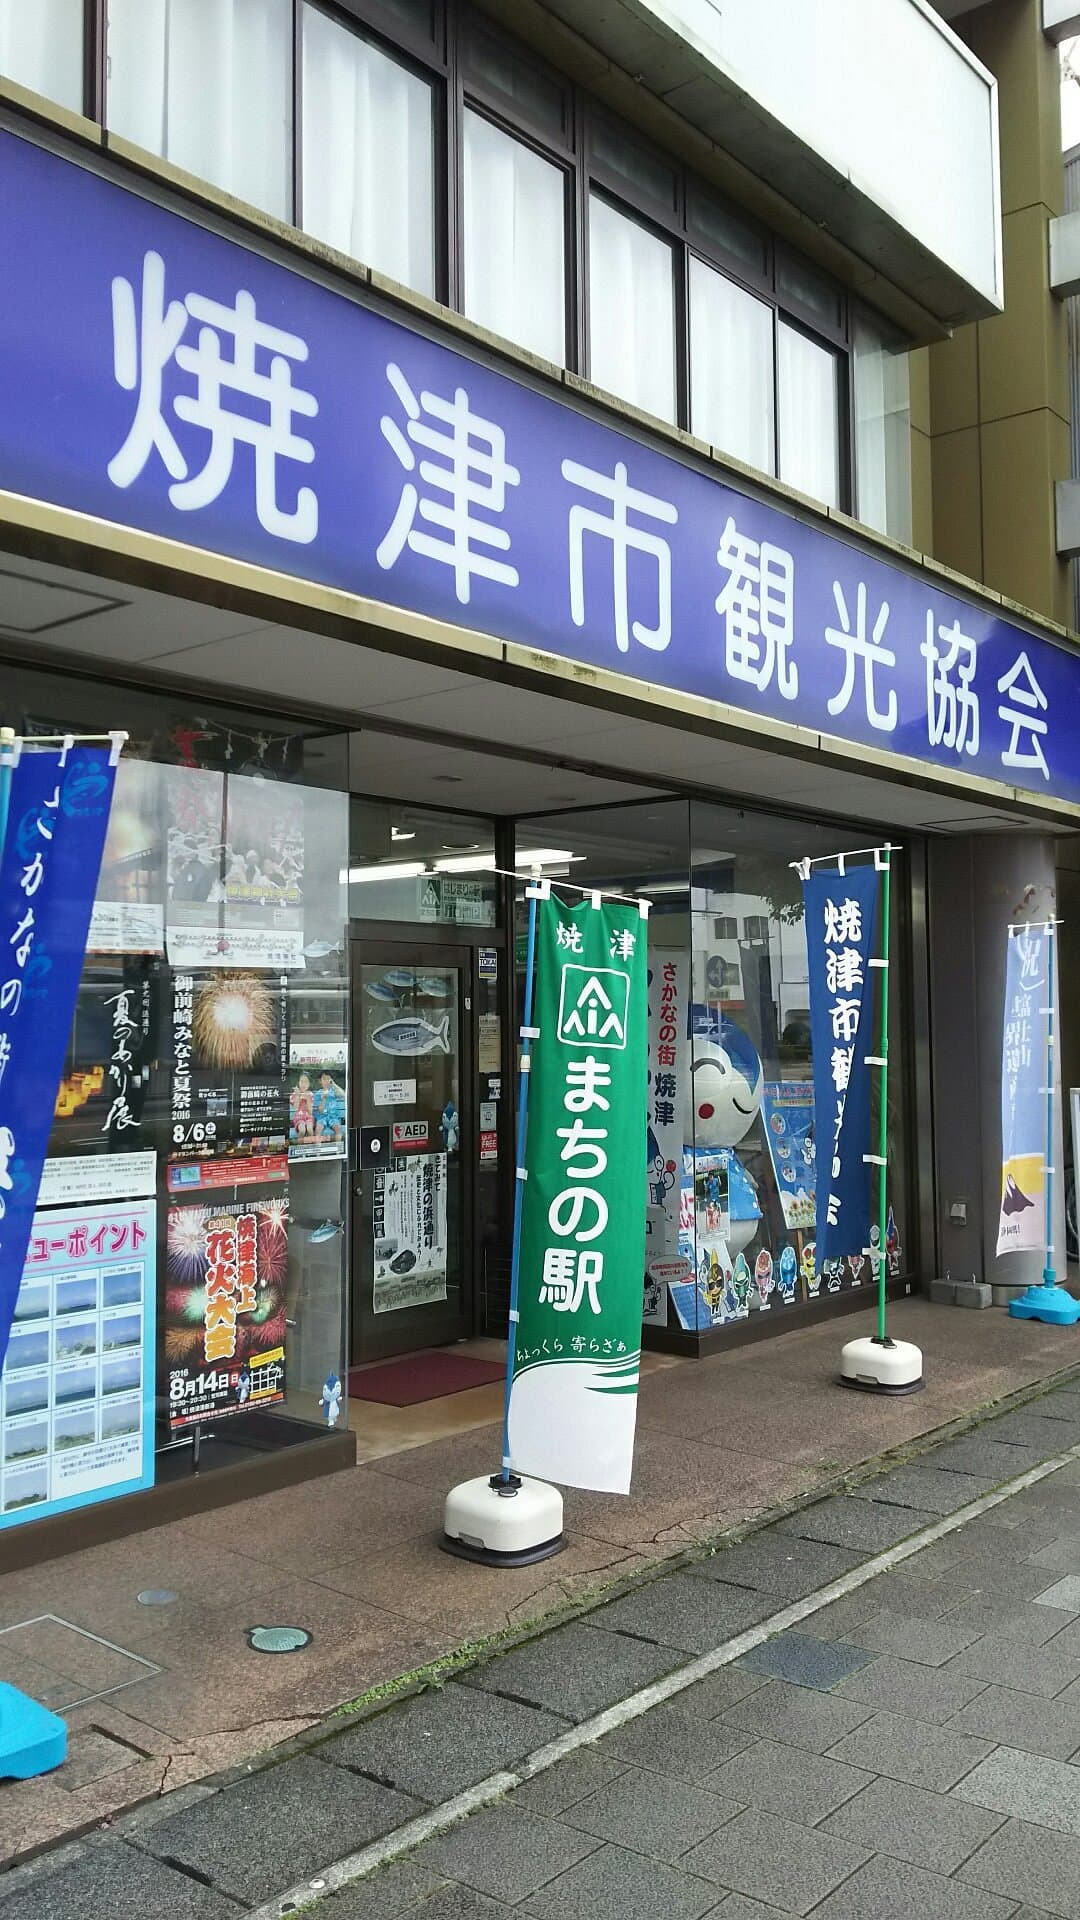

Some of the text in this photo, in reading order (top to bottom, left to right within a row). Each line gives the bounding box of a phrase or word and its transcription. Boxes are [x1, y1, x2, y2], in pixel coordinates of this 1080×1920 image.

[108, 250, 1051, 780] 焼津市観光協会
[102, 990, 141, 1131] 夏のあかり展
[172, 976, 193, 1110] 御前崎みなと夏祭
[654, 962, 677, 1127] さかなの街 焼津
[171, 1110, 191, 1121] 2016
[173, 1122, 205, 1143] 8/6
[404, 1125, 427, 1137] AED
[538, 1056, 612, 1315] まちの駅
[25, 1220, 147, 1262] ューポイント
[205, 1229, 236, 1362] 花火大会
[517, 1335, 627, 1362] ちょっくら 寄らざぁ
[169, 1368, 189, 1380] 2016
[170, 1370, 229, 1400] 8月14日
